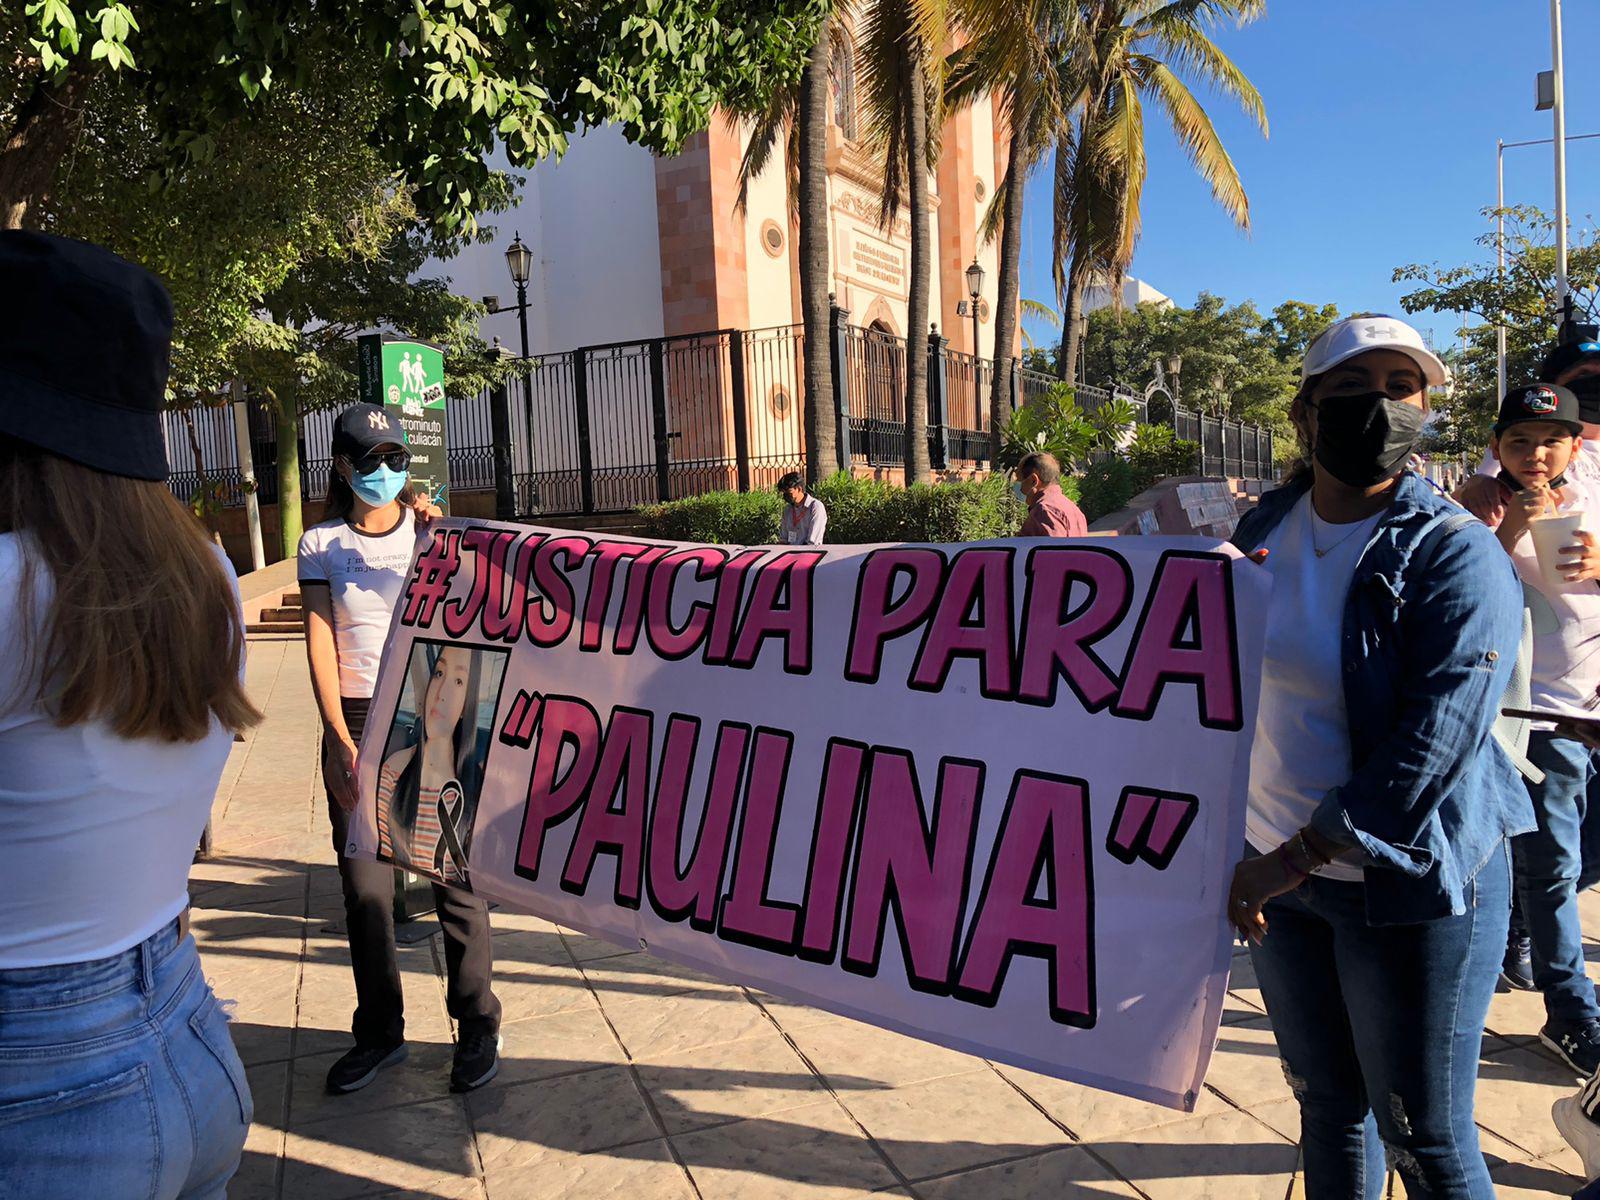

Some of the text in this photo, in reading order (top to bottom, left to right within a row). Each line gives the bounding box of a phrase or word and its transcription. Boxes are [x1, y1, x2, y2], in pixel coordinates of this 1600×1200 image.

[408, 432, 442, 446] culiacán
[386, 561, 409, 571] happ
[401, 526, 1244, 732] #JUSTICIA PARA
[499, 688, 1199, 1030] "PAULINA"
